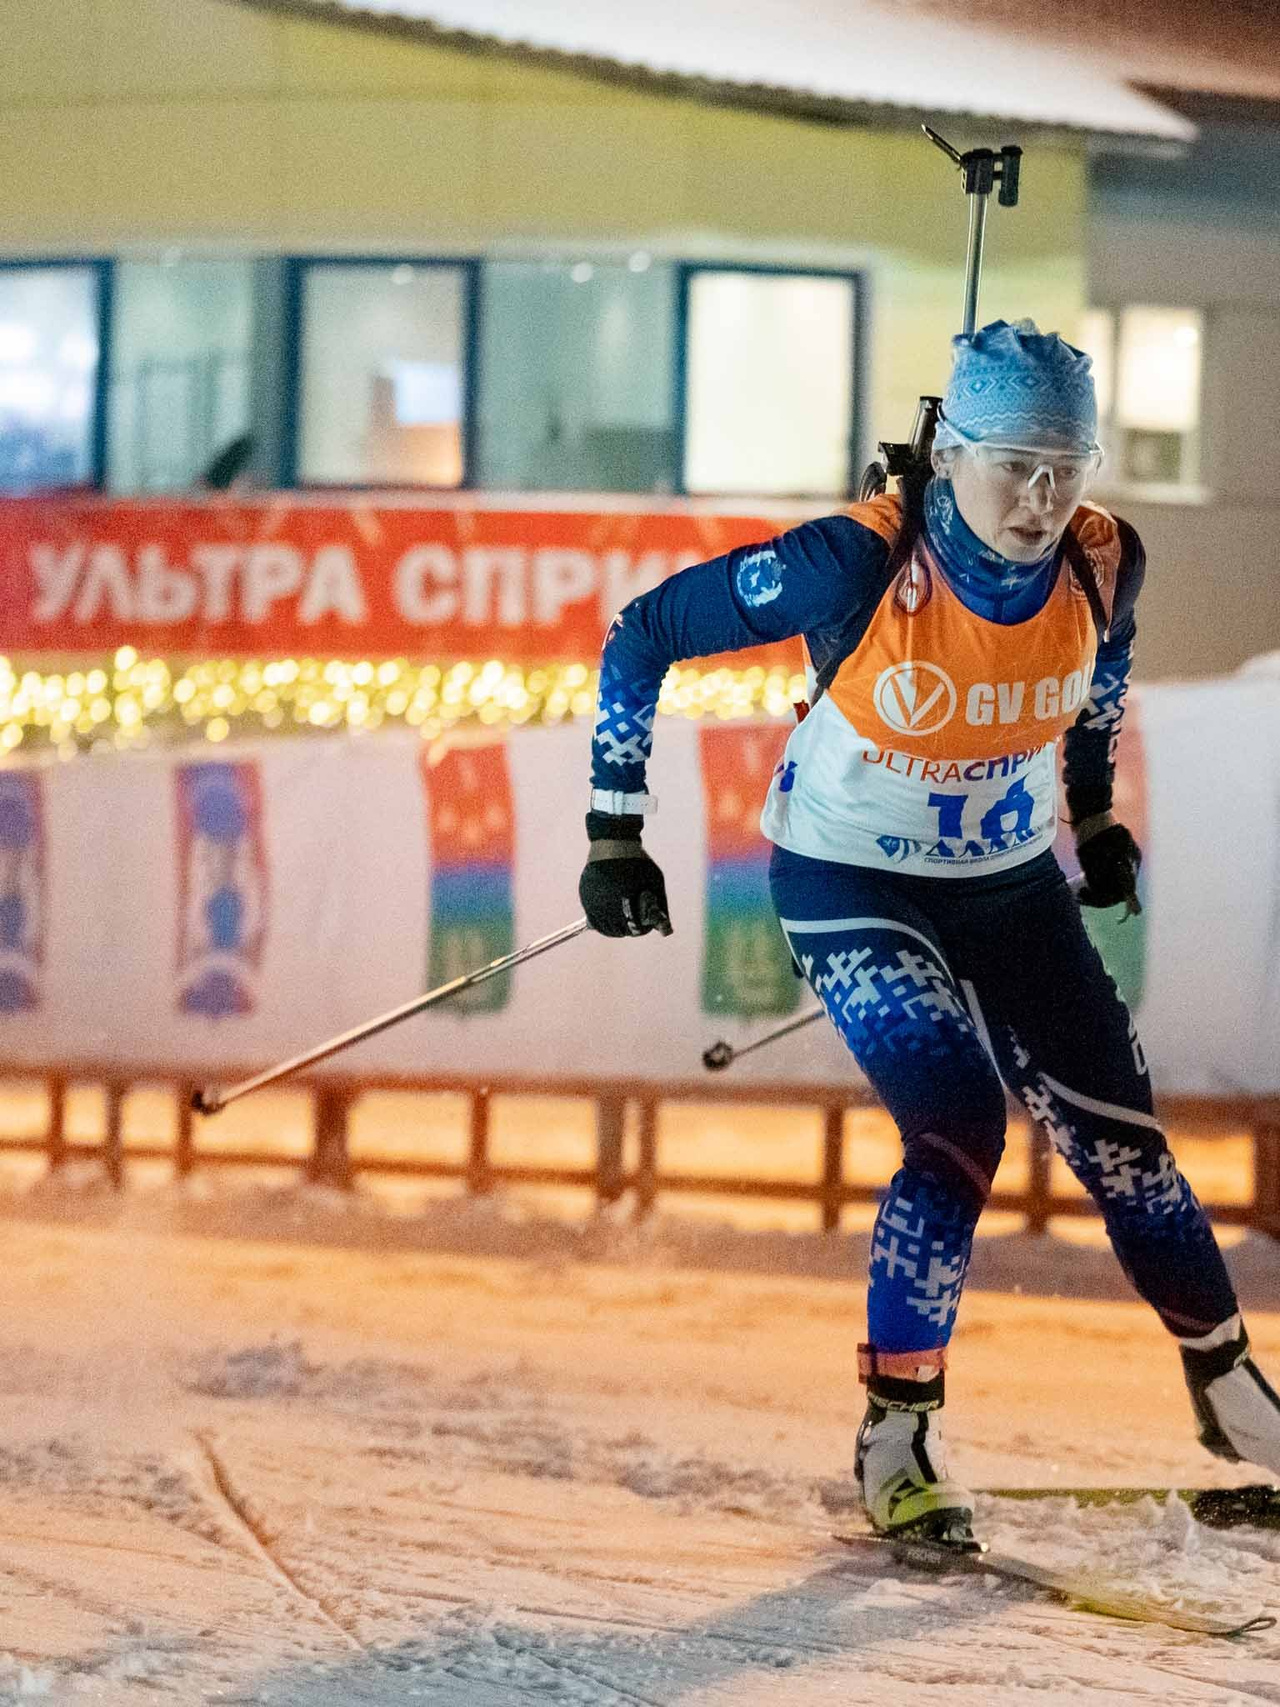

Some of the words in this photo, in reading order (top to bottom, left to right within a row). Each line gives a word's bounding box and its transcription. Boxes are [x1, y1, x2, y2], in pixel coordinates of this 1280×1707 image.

[30, 541, 369, 624] УЛЬТРА
[394, 543, 701, 625] СПРИ
[966, 682, 1025, 726] GV
